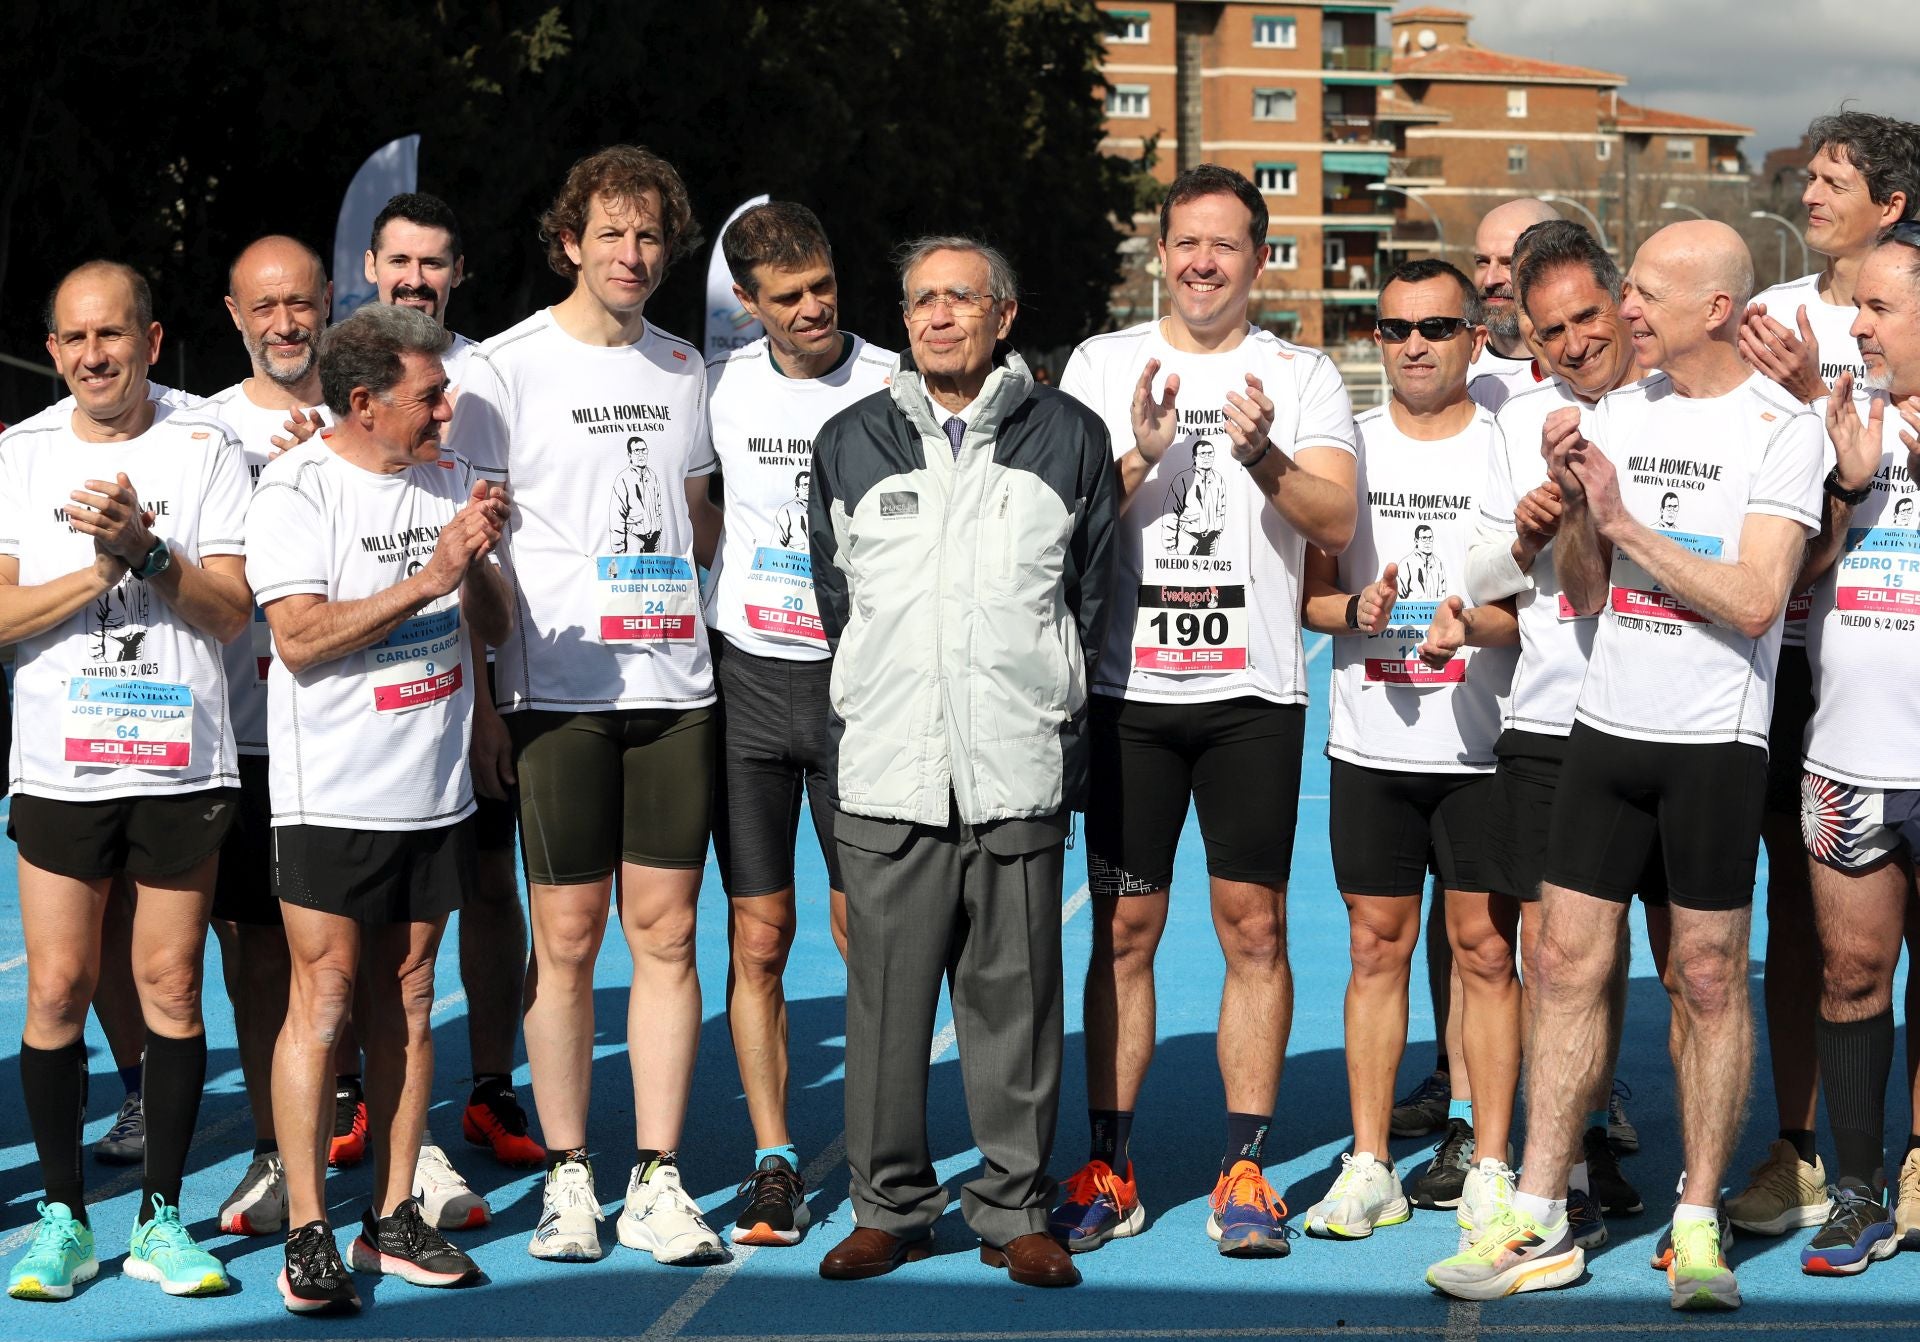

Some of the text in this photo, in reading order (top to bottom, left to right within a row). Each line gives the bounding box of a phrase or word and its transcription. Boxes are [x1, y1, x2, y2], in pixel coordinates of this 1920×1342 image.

[572, 404, 672, 424] MILLA HOMENAJE
[588, 422, 665, 435] MARTÍN VELASCO
[1195, 426, 1226, 437] VELAS
[747, 437, 783, 453] MILLA
[758, 455, 795, 466] MARTÍN
[1627, 456, 1723, 482] MILLA HOMENAJE
[1633, 474, 1705, 491] MARTÍN VELASCO
[1367, 492, 1472, 510] MILLA HOMENAJE
[1379, 508, 1457, 521] MARTÍN VELASCO
[361, 534, 397, 552] MILLA
[378, 549, 405, 564] MARTÍ
[1843, 557, 1892, 570] PEDRO
[1155, 559, 1232, 573] TOLEDO 8/2/025
[766, 574, 807, 588] ANTONIO
[1883, 574, 1903, 588] 15
[611, 584, 687, 593] RUBEN LOZANO
[644, 601, 665, 615] 24
[782, 595, 804, 611] 20
[623, 619, 682, 630] SOLISS
[758, 609, 824, 631] SOLISS
[1617, 615, 1683, 636] TOLEDO 8/2/025
[1841, 614, 1915, 632] TOLEDO 8/2/025
[1150, 611, 1229, 647] 190
[376, 646, 428, 663] CARLOS
[1156, 650, 1223, 663] SOLISS
[82, 663, 159, 678] TOLEDO 8/2/025
[426, 662, 435, 676] 9
[400, 673, 455, 698] SOLISS
[106, 707, 146, 718] PEDRO
[151, 709, 185, 719] VILLA
[117, 725, 139, 739] 64
[90, 742, 167, 756] SOLISS
